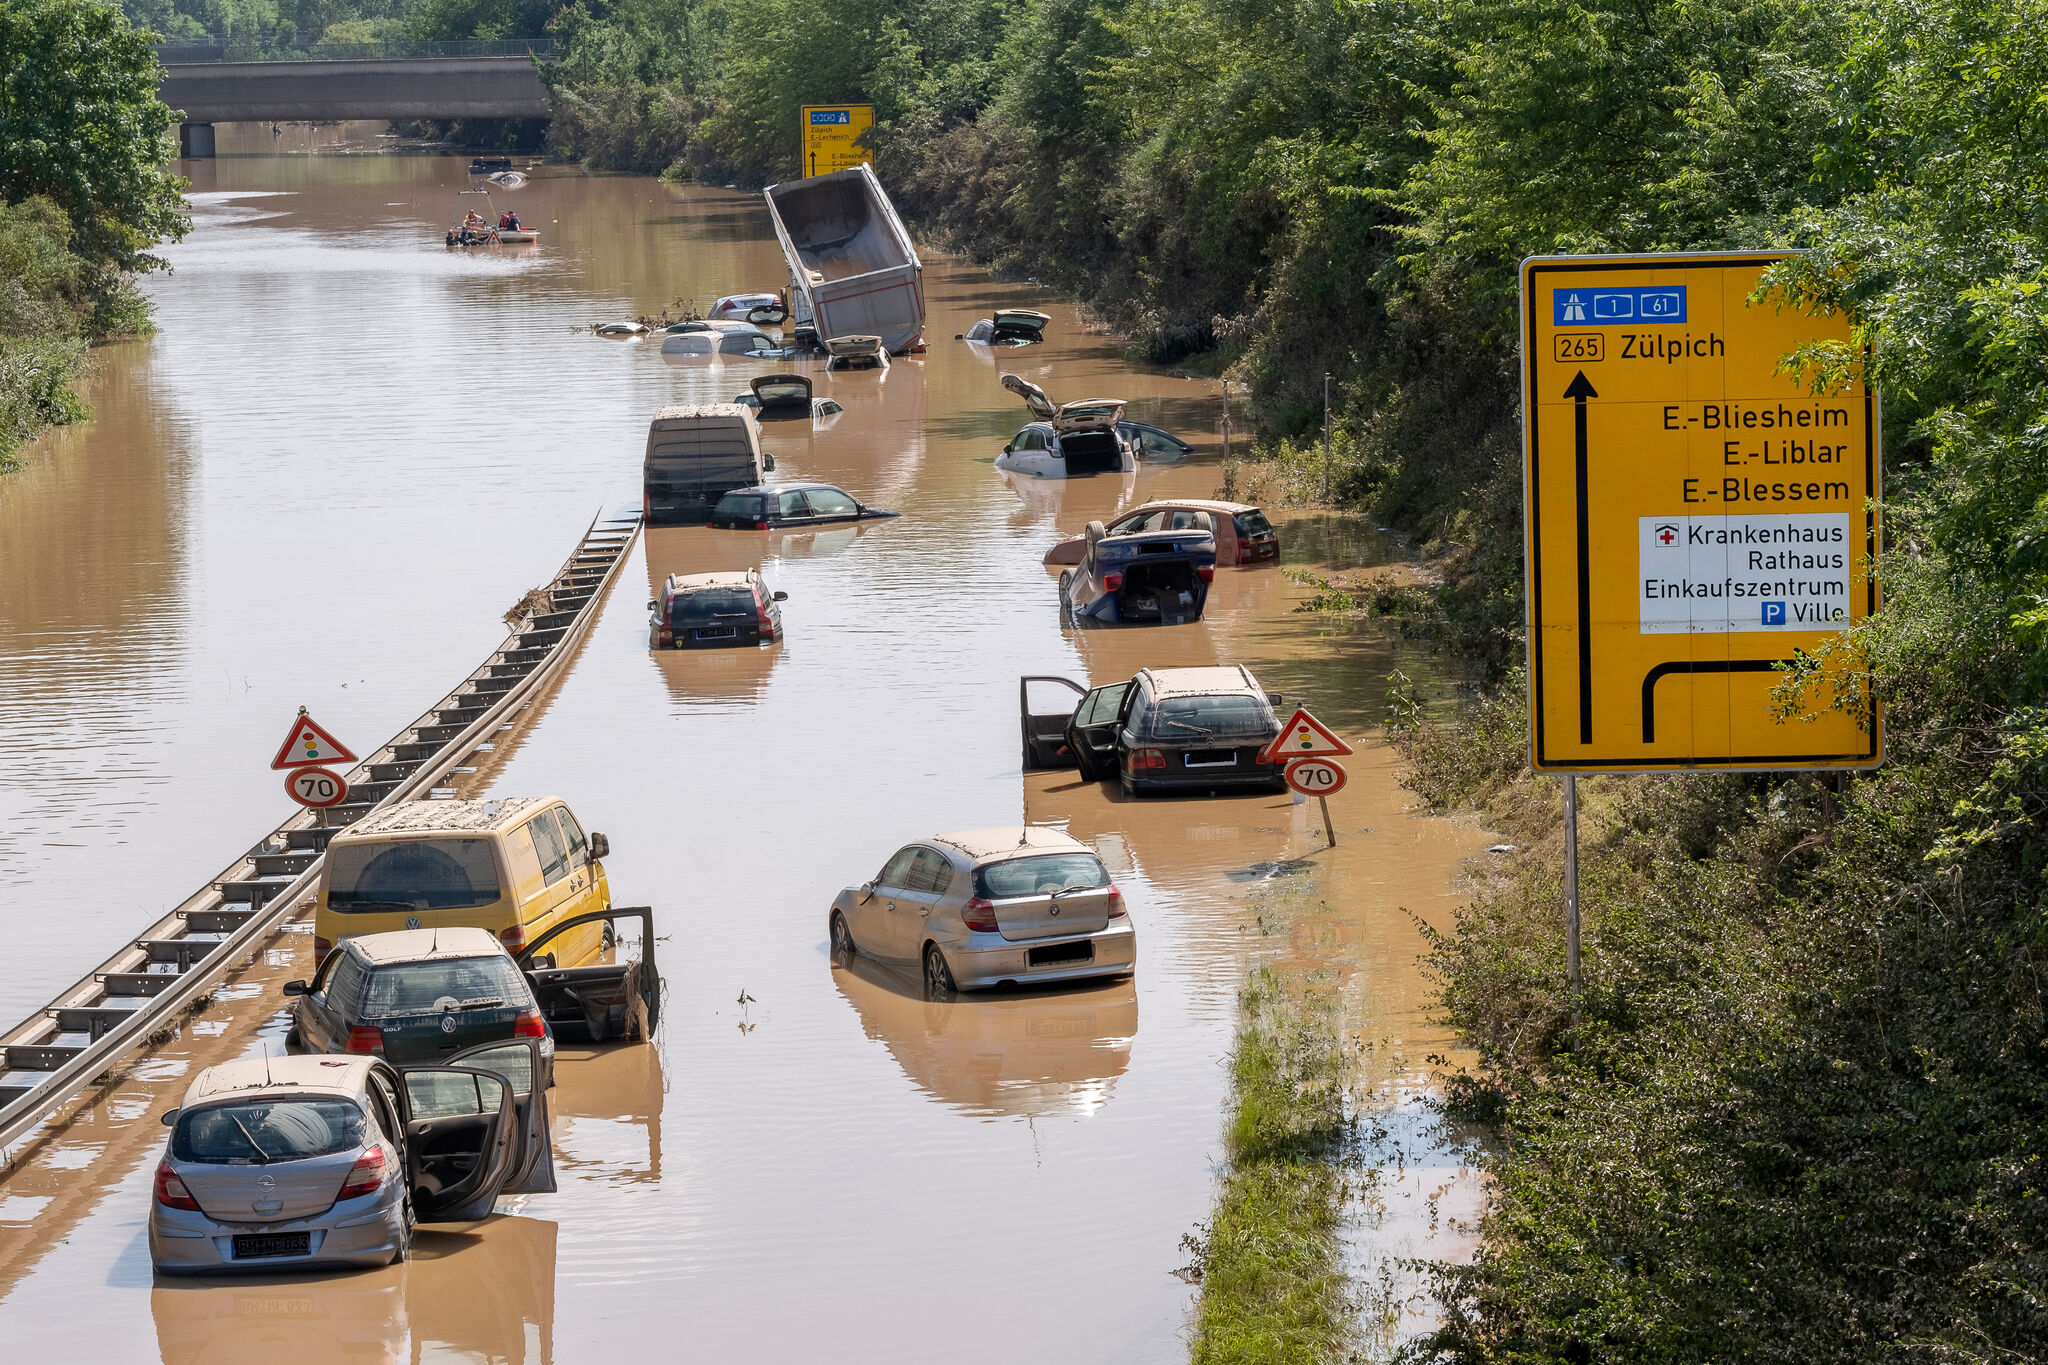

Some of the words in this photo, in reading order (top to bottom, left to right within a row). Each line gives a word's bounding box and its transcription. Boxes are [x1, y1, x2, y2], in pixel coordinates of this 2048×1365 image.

[1611, 299, 1617, 313] 1
[1653, 298, 1668, 312] 61
[1561, 338, 1598, 357] 265
[1621, 332, 1725, 364] Zülpich
[1663, 402, 1848, 430] E.-Bliesheim
[1724, 440, 1848, 466] E.-Liblar
[1683, 477, 1849, 503] E.-Blessem
[1688, 524, 1843, 545] Krankenhaus
[1749, 550, 1843, 570] Rathaus
[1645, 578, 1844, 599] Einkaufszentrum
[1793, 602, 1844, 622] Ville
[1299, 768, 1334, 786] 70
[300, 779, 334, 797] 70
